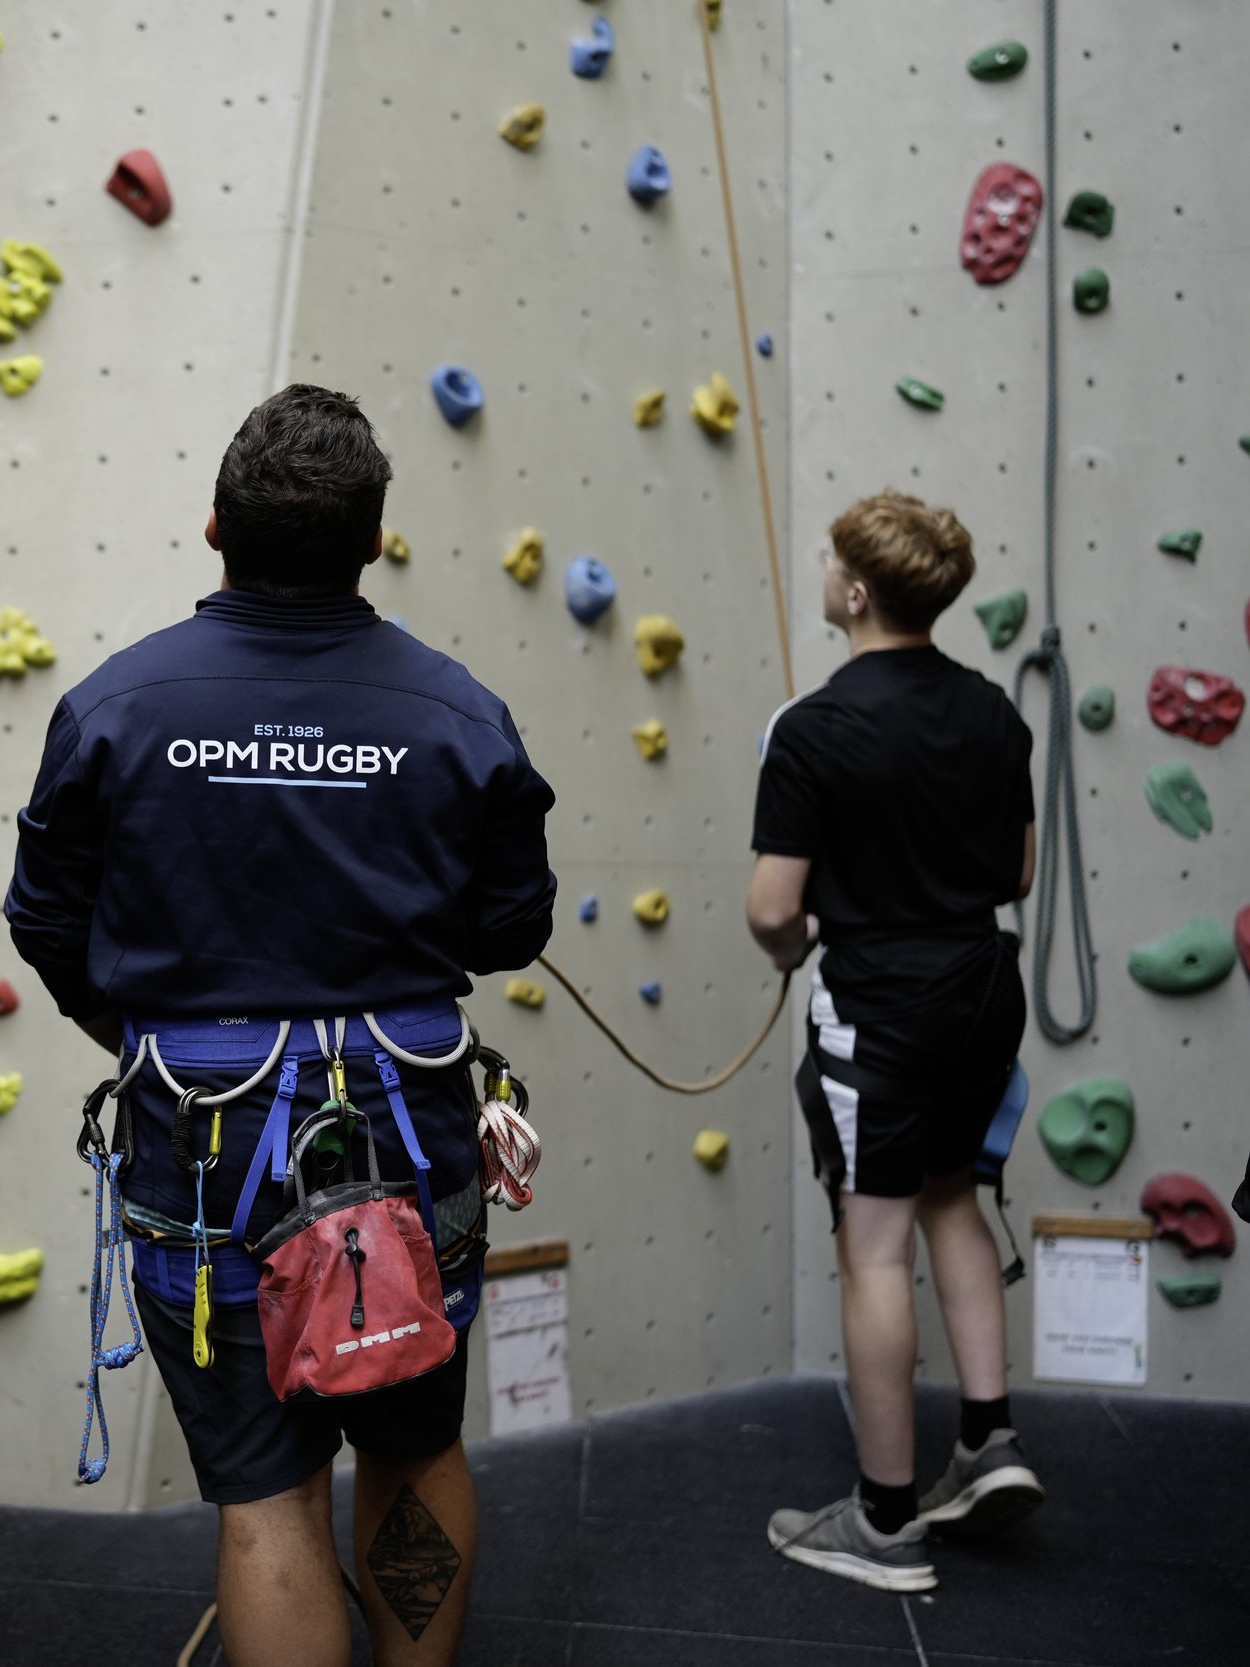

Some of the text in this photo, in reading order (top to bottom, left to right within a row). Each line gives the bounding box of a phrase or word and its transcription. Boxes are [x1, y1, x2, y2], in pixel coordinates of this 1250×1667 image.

[254, 724, 324, 738] EST. 1926
[167, 739, 409, 775] OPM RUGBY
[218, 1016, 249, 1026] CORAX
[335, 1321, 421, 1355] DMM
